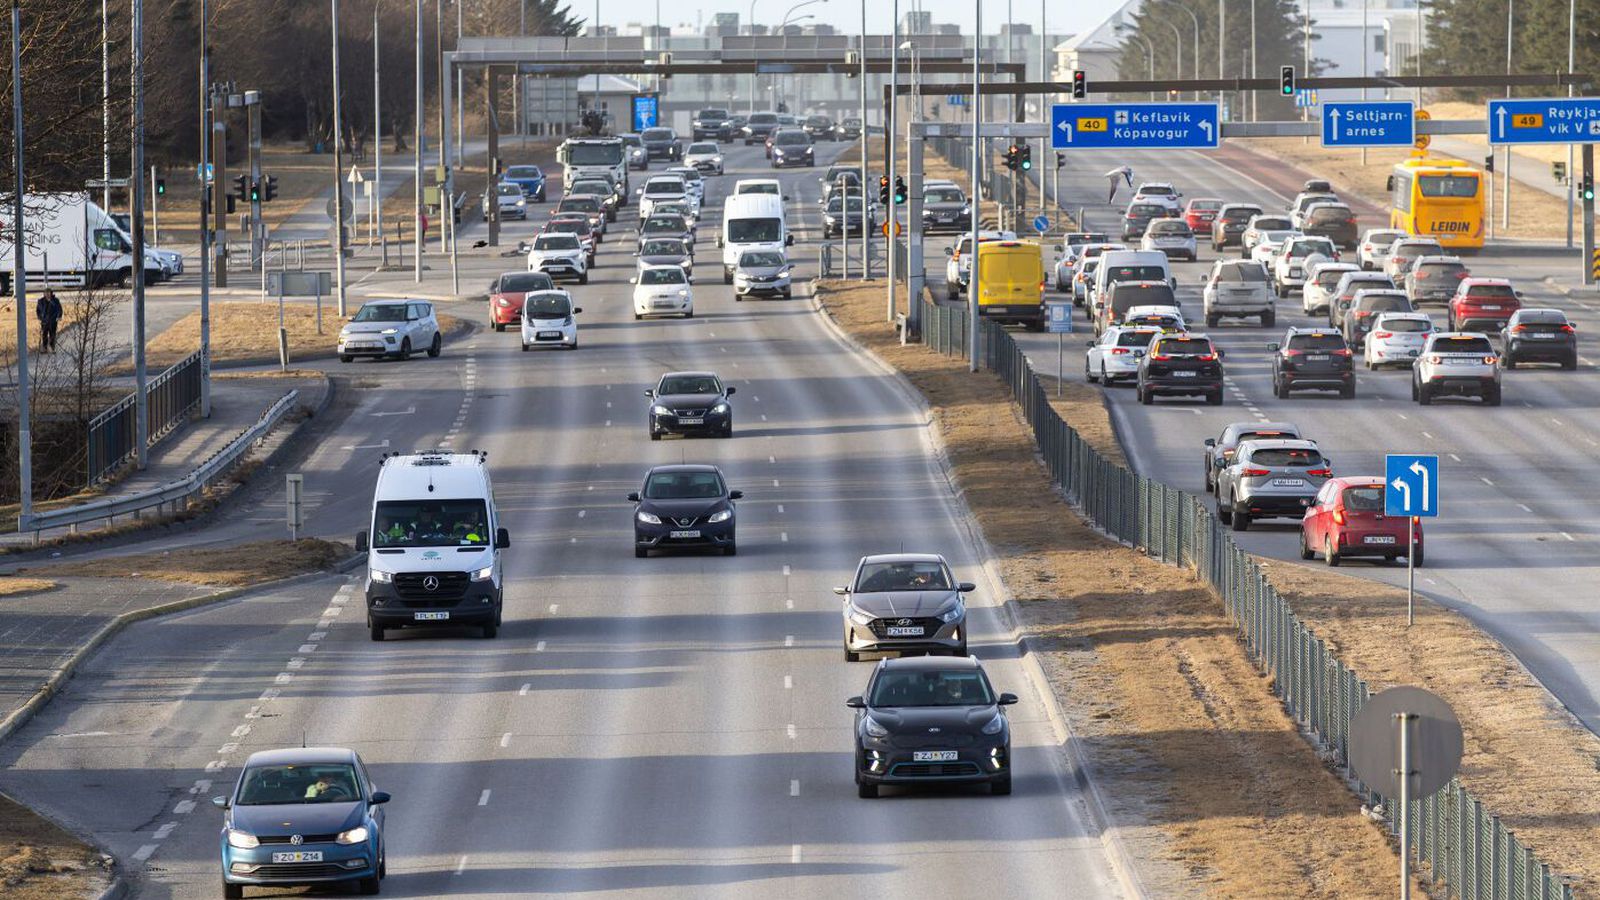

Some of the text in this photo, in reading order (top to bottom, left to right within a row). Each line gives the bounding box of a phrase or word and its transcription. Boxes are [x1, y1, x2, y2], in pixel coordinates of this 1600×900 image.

[1132, 112, 1191, 123] Keflavík
[1346, 110, 1408, 123] Seltjarn-
[1520, 116, 1536, 125] 49
[1084, 120, 1100, 130] 40
[1575, 122, 1583, 133] V
[1114, 127, 1189, 140] Kópavogur
[1346, 127, 1385, 136] arnes
[940, 751, 956, 759] Y27
[303, 852, 319, 861] Z14
